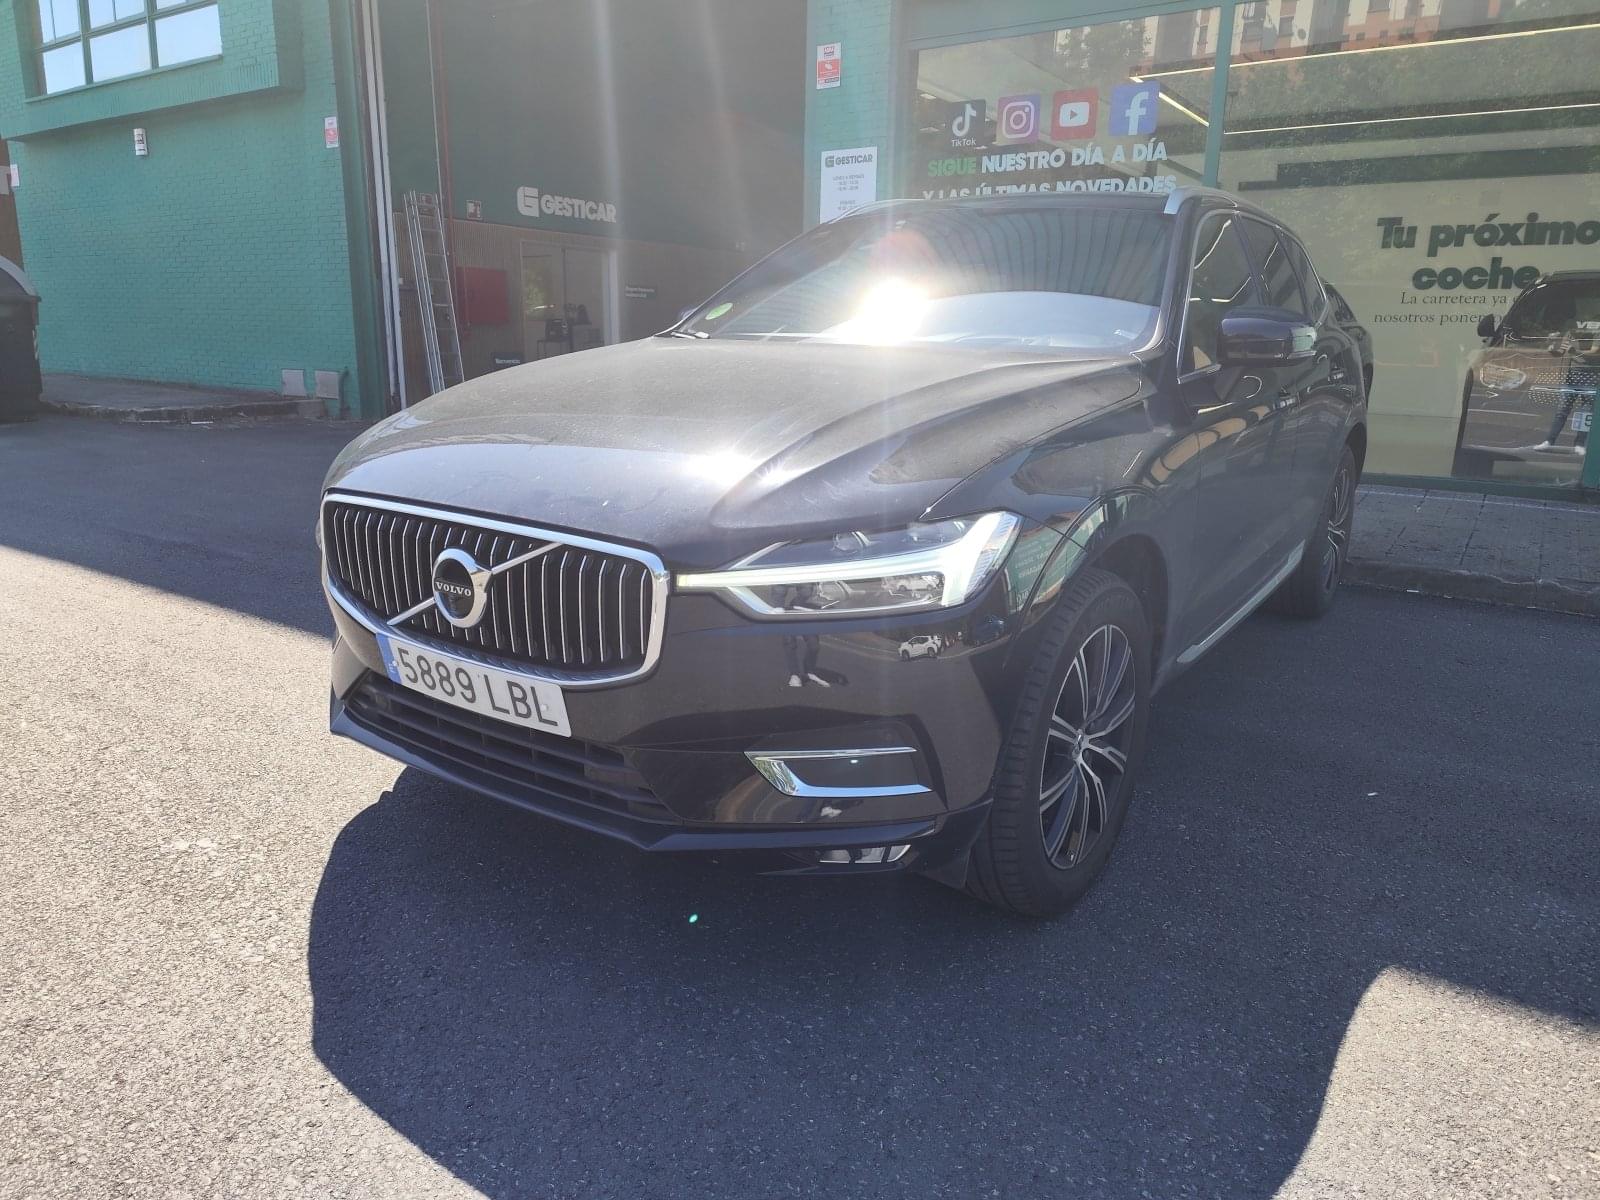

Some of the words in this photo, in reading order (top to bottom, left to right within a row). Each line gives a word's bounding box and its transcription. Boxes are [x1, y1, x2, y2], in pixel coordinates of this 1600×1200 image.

[951, 137, 977, 147] TikTok
[835, 154, 873, 166] GESTICAR
[927, 157, 977, 177] SIGUE
[981, 148, 1066, 173] NUESTRO
[1071, 142, 1105, 166] DÍA
[1111, 144, 1126, 163] A
[1132, 137, 1168, 161] DÍA
[1056, 175, 1177, 193] NOVEDADES
[541, 194, 617, 222] GESTICAR
[1376, 217, 1418, 249] Tu
[1427, 212, 1600, 257] próximo
[1412, 257, 1541, 290] coche
[1401, 291, 1417, 305] La
[1422, 294, 1486, 304] carretera
[1492, 294, 1507, 306] ya
[1374, 312, 1435, 323] nosotros
[435, 581, 472, 597] VOLVO
[398, 647, 477, 704] 5889
[483, 674, 559, 727] LBL
